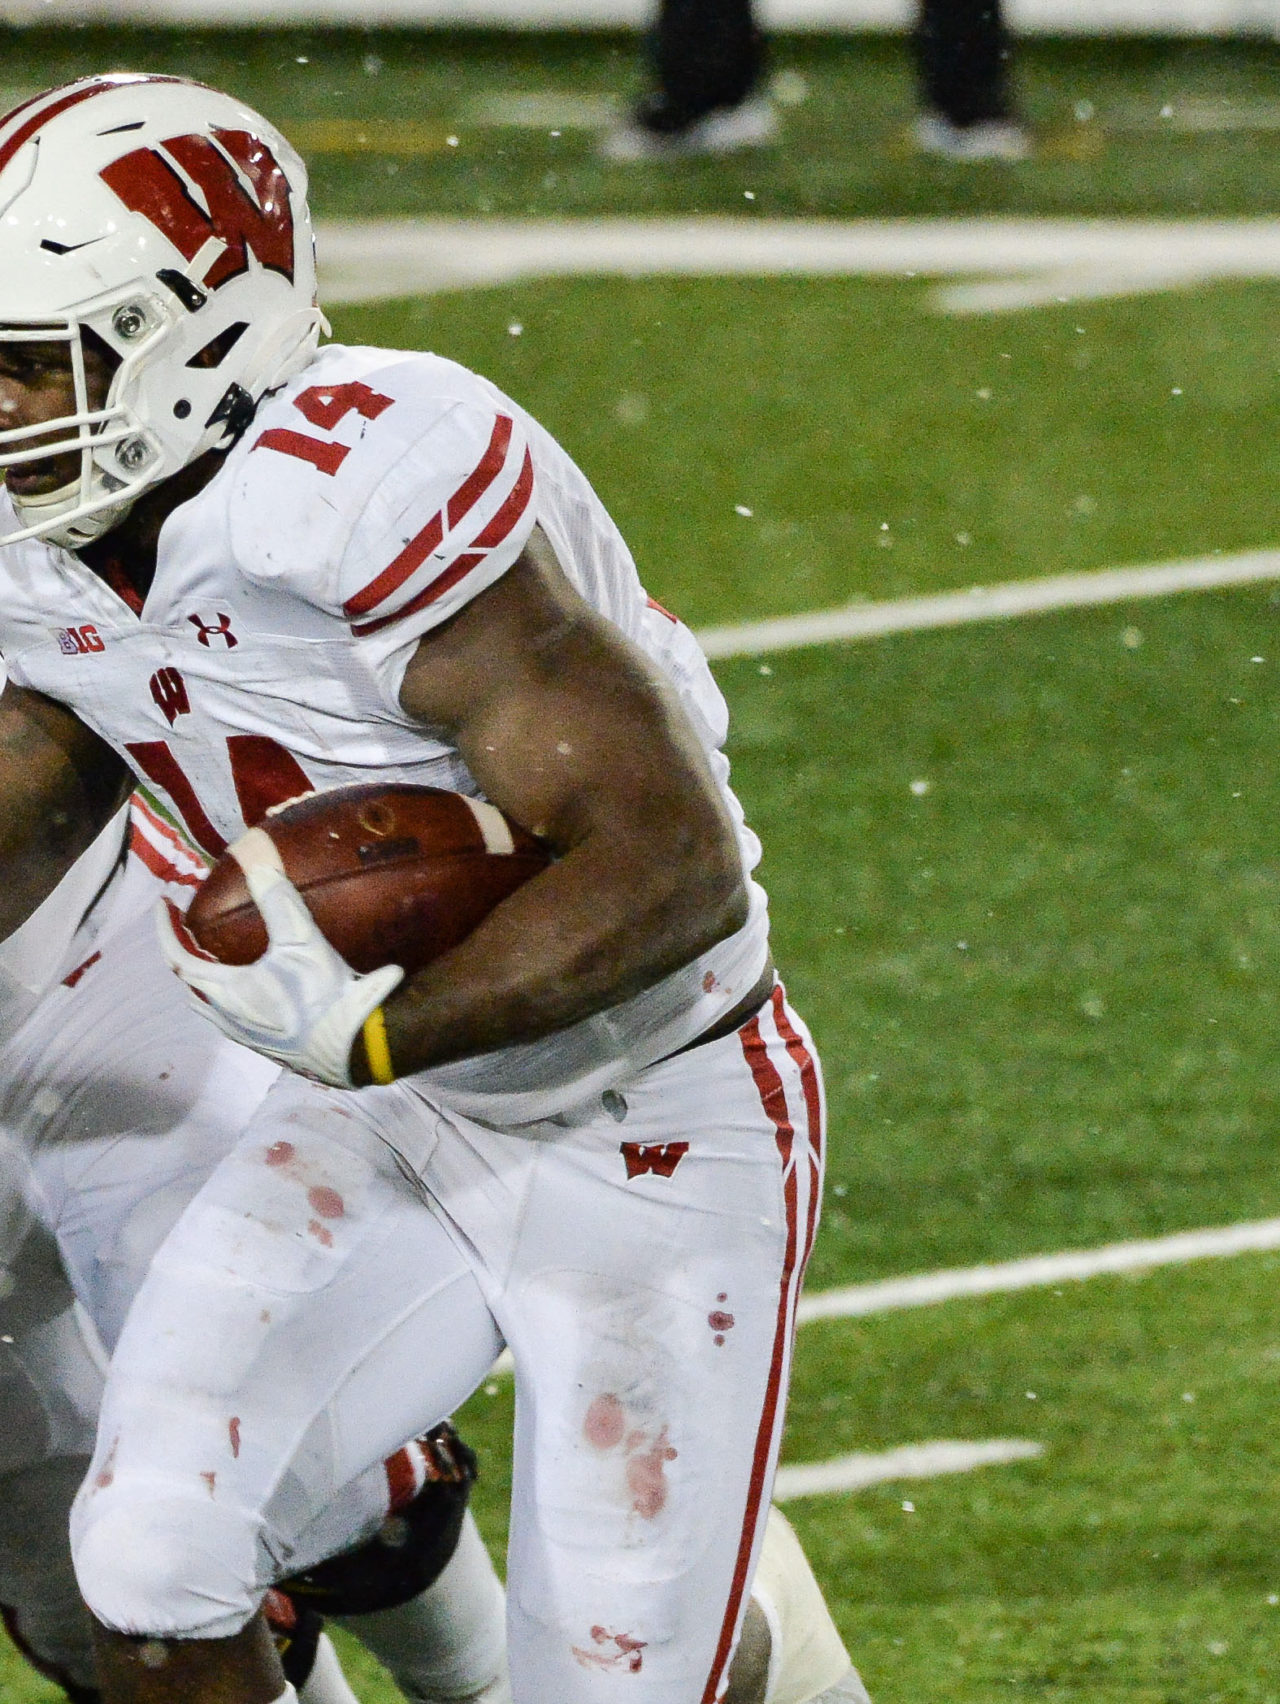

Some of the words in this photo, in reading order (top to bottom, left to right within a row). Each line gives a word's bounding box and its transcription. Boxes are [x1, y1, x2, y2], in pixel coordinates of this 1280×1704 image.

[99, 129, 294, 291] W
[248, 380, 396, 477] 14
[620, 1141, 689, 1180] W
